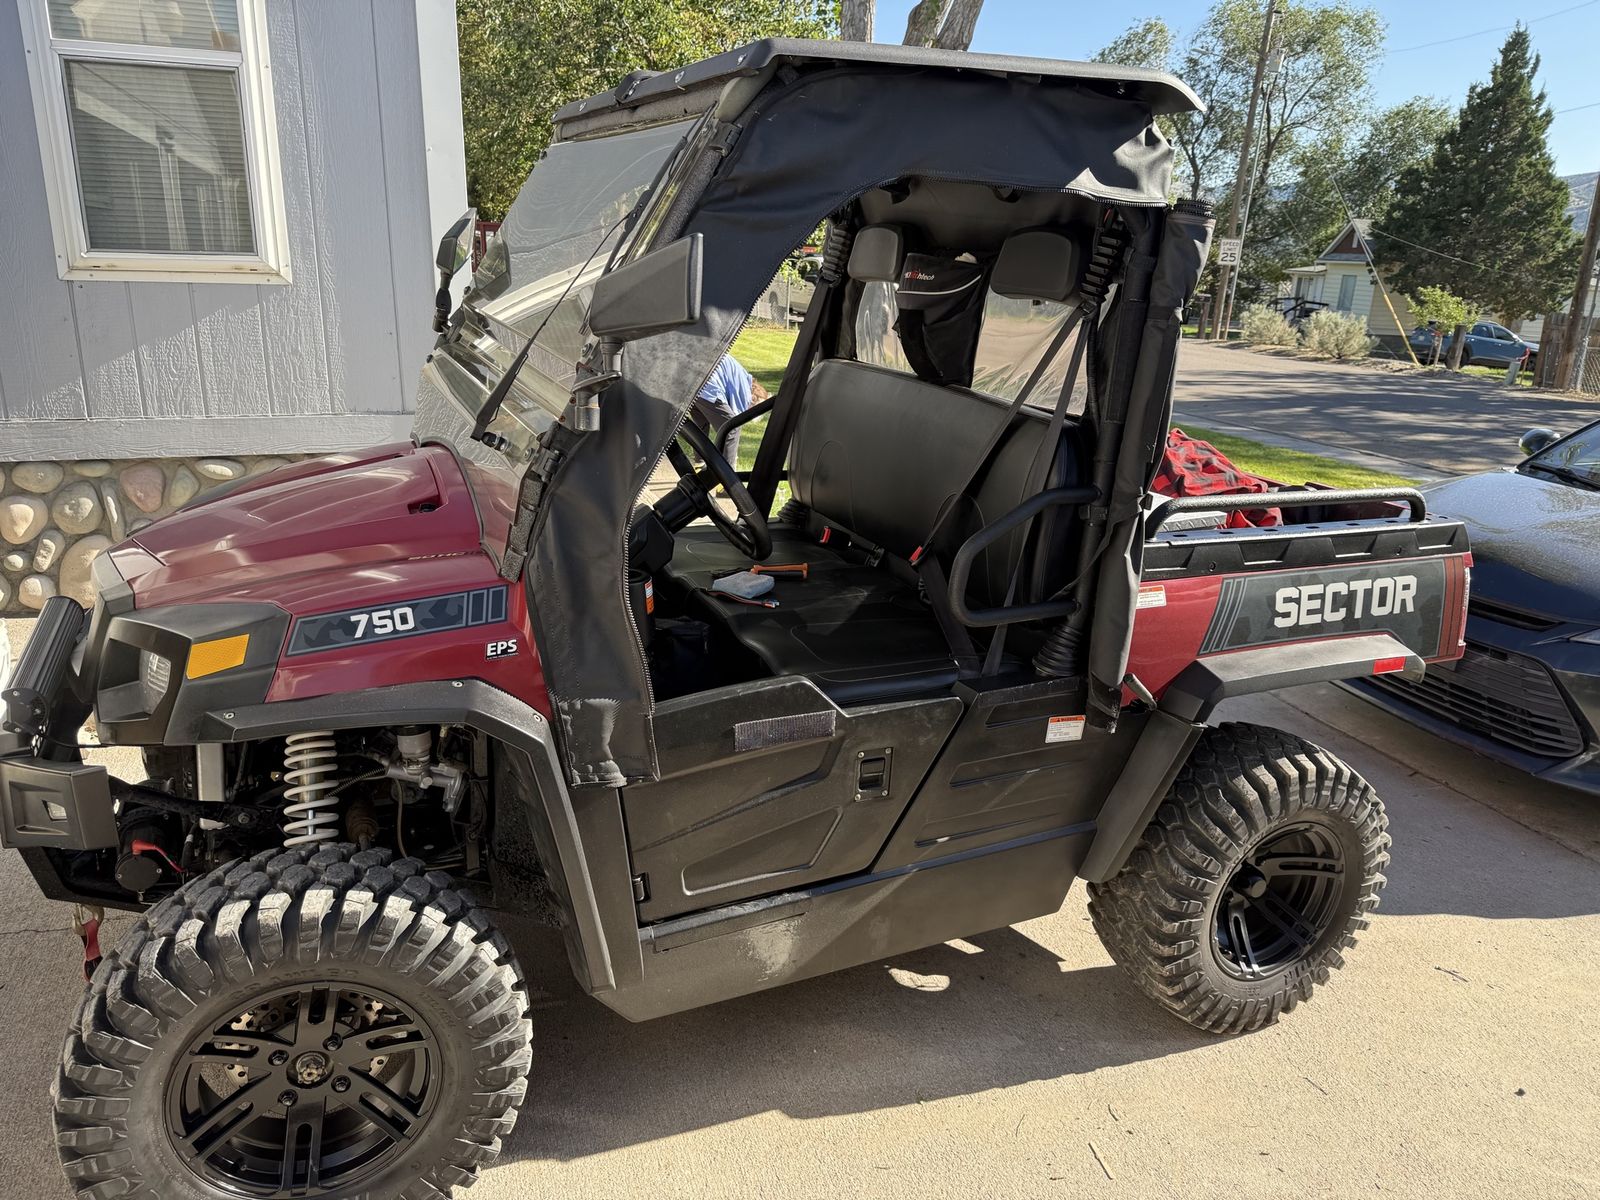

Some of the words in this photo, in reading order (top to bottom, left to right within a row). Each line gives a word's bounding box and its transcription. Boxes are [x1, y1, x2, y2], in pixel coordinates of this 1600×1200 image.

[1221, 252, 1237, 262] 25
[1274, 575, 1417, 628] SECTOR
[350, 607, 415, 638] 750
[486, 639, 517, 656] EPS
